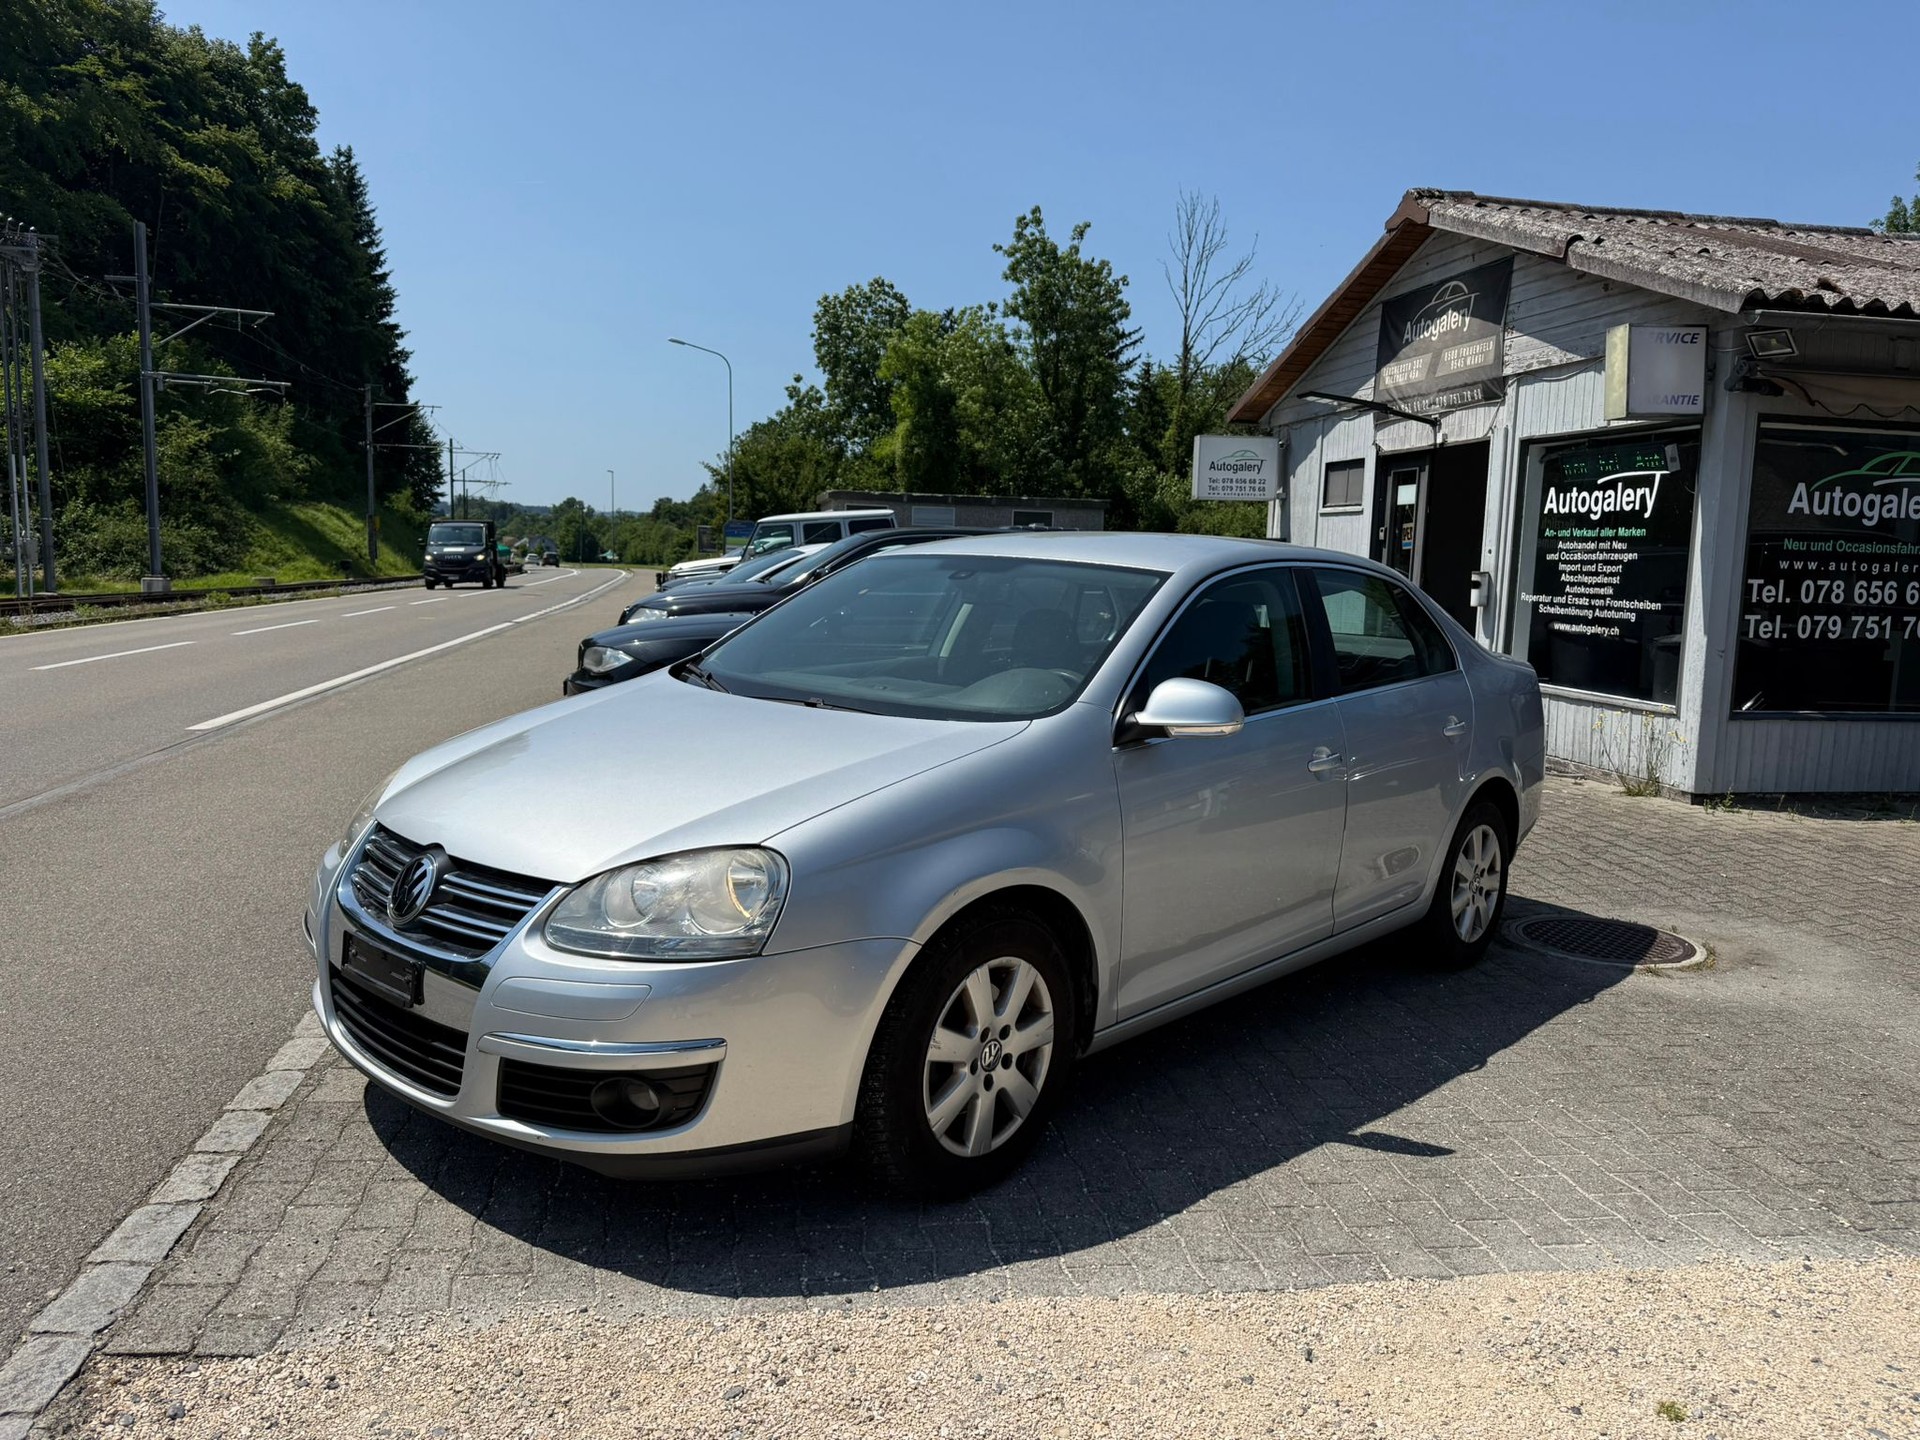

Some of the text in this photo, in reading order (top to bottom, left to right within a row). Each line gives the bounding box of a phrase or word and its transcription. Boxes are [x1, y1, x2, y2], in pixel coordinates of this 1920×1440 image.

[1402, 299, 1474, 344] Autogalery
[1209, 460, 1264, 475] Autogalery
[1544, 476, 1660, 521] Autogalery
[1787, 482, 1920, 526] Autogale
[1544, 527, 1646, 537] An- und Verkauf aller Marken
[1558, 540, 1627, 549] Autohandel mit Neu
[1783, 538, 1920, 555] Neu und Occasionsfahr
[1546, 551, 1638, 562] und Occasionsfahrzeugen
[1559, 562, 1622, 574] Import und Export
[1560, 573, 1620, 584] Abschleppdienst
[1565, 584, 1614, 595] Autokosmetik
[1747, 579, 1791, 603] Tel.
[1800, 579, 1845, 604] 078
[1854, 580, 1898, 605] 656
[1521, 592, 1662, 610] Reperatur und Ersatz von Frontscheiben
[1538, 604, 1636, 622] Scheibentönung Autotuning
[1553, 622, 1619, 637] www.autogalery.ch
[1744, 614, 1920, 639] Tel. 079 751 7
